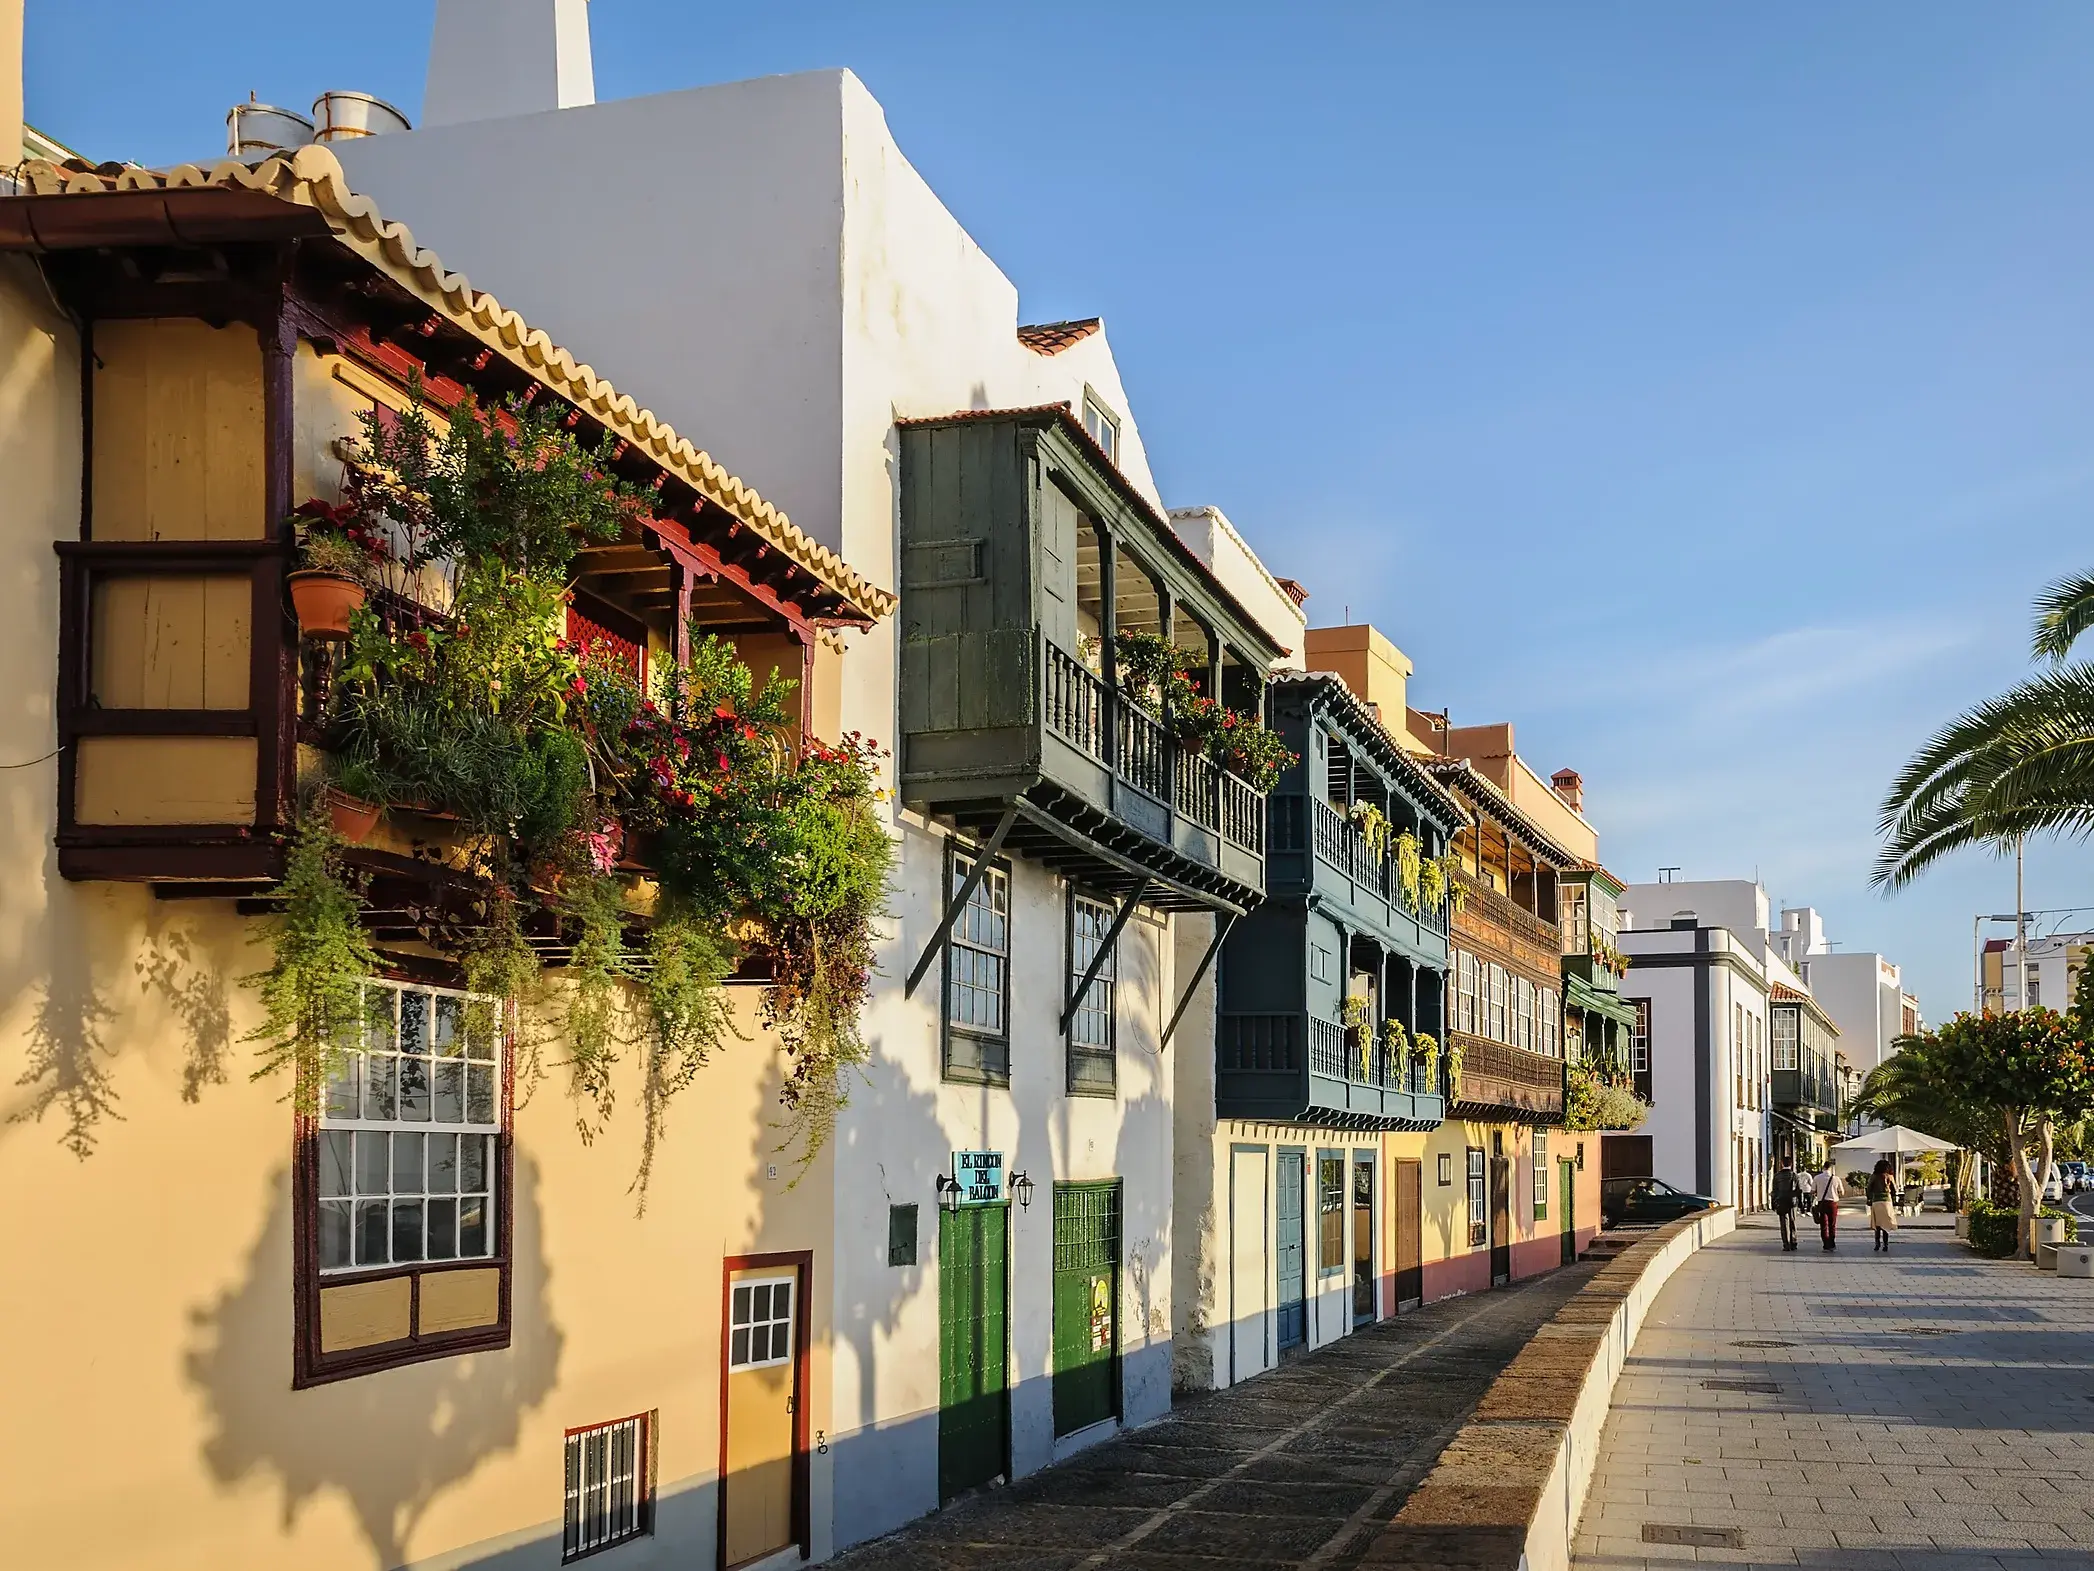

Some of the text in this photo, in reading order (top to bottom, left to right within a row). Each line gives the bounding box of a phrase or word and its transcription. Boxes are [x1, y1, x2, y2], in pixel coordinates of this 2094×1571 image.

[961, 1154, 1002, 1168] EL RINCON
[975, 1170, 990, 1184] DEL
[969, 1185, 999, 1200] BALCON
